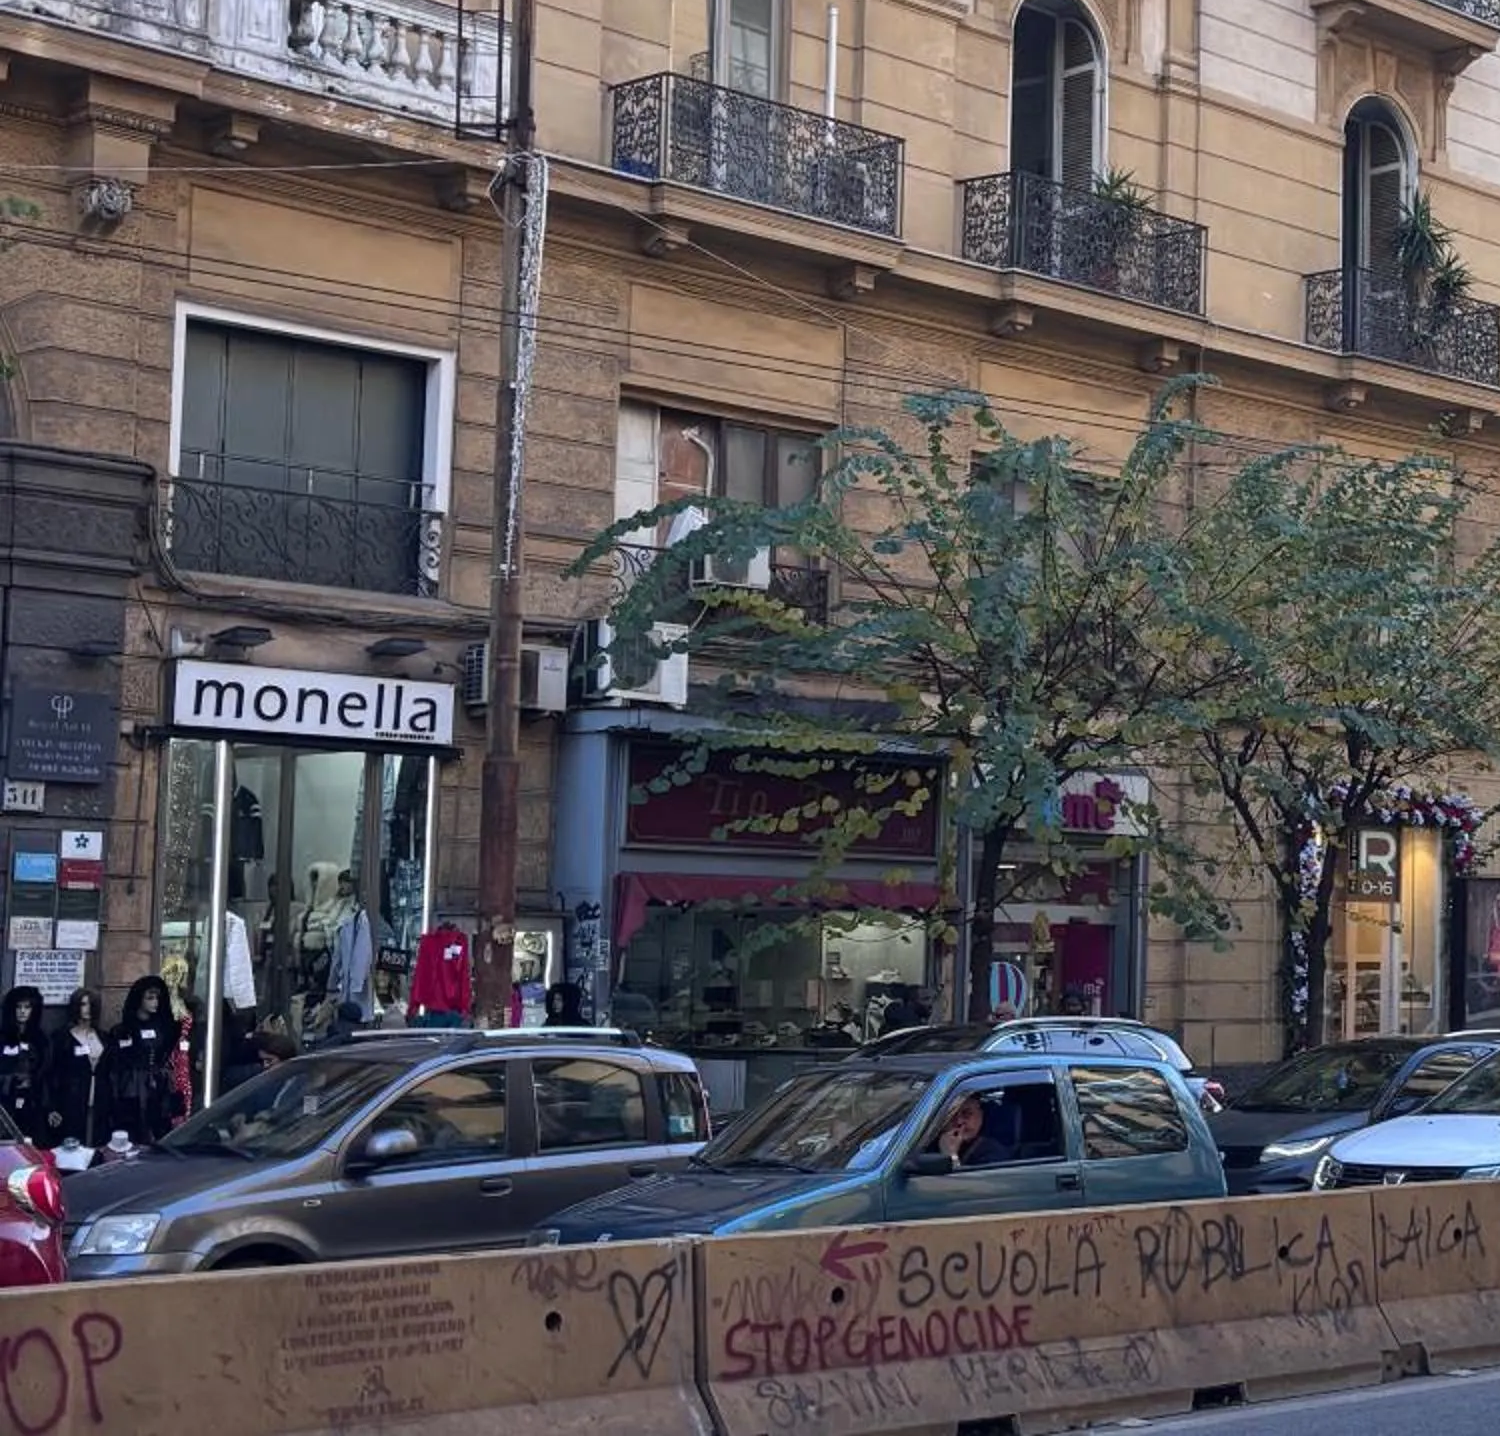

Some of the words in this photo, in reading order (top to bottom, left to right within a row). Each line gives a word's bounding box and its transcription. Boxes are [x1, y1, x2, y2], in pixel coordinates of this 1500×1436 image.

[193, 679, 438, 733] monella
[898, 1225, 1106, 1308] SCUOLA
[718, 1316, 837, 1382] STOP
[843, 1304, 1034, 1364] GENOCIDE
